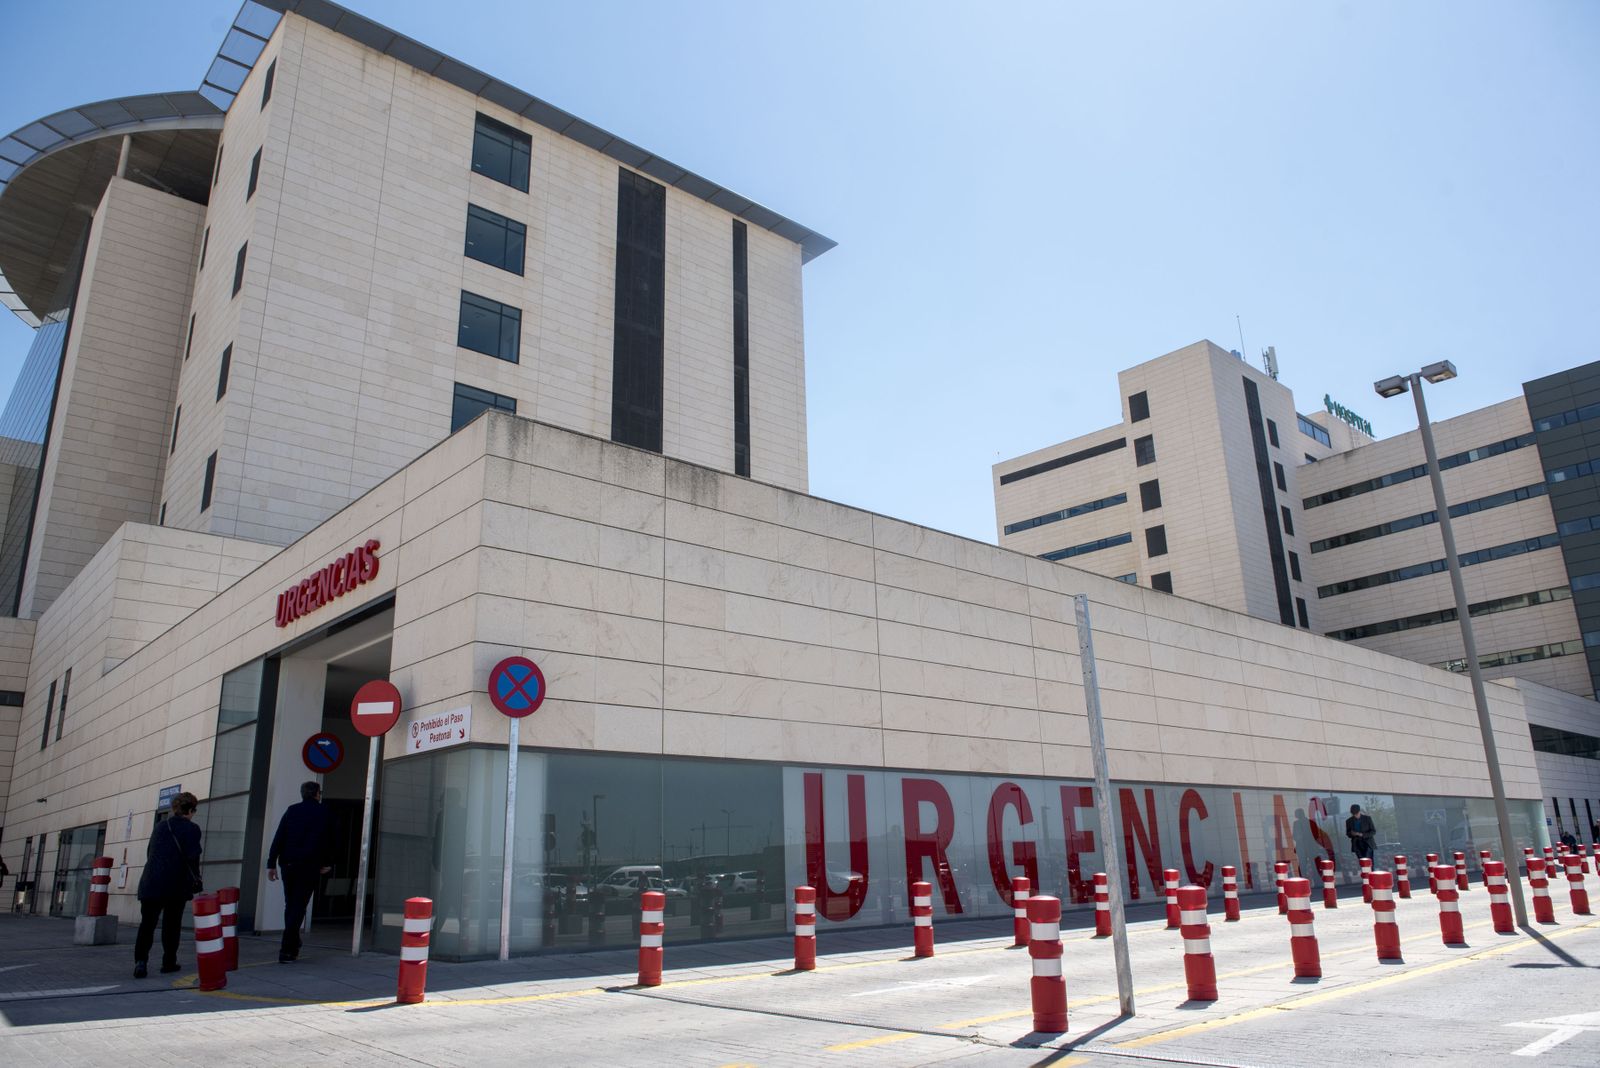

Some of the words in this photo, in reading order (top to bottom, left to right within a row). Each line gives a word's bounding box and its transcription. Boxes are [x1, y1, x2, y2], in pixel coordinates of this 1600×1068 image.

[1333, 401, 1375, 438] HOSPITAL
[275, 539, 381, 628] URGENCIAS
[420, 716, 444, 732] Prohibido
[444, 714, 450, 726] el
[450, 713, 464, 725] Paso
[429, 728, 452, 743] Peatonal
[803, 772, 1336, 922] URGENCIAS
